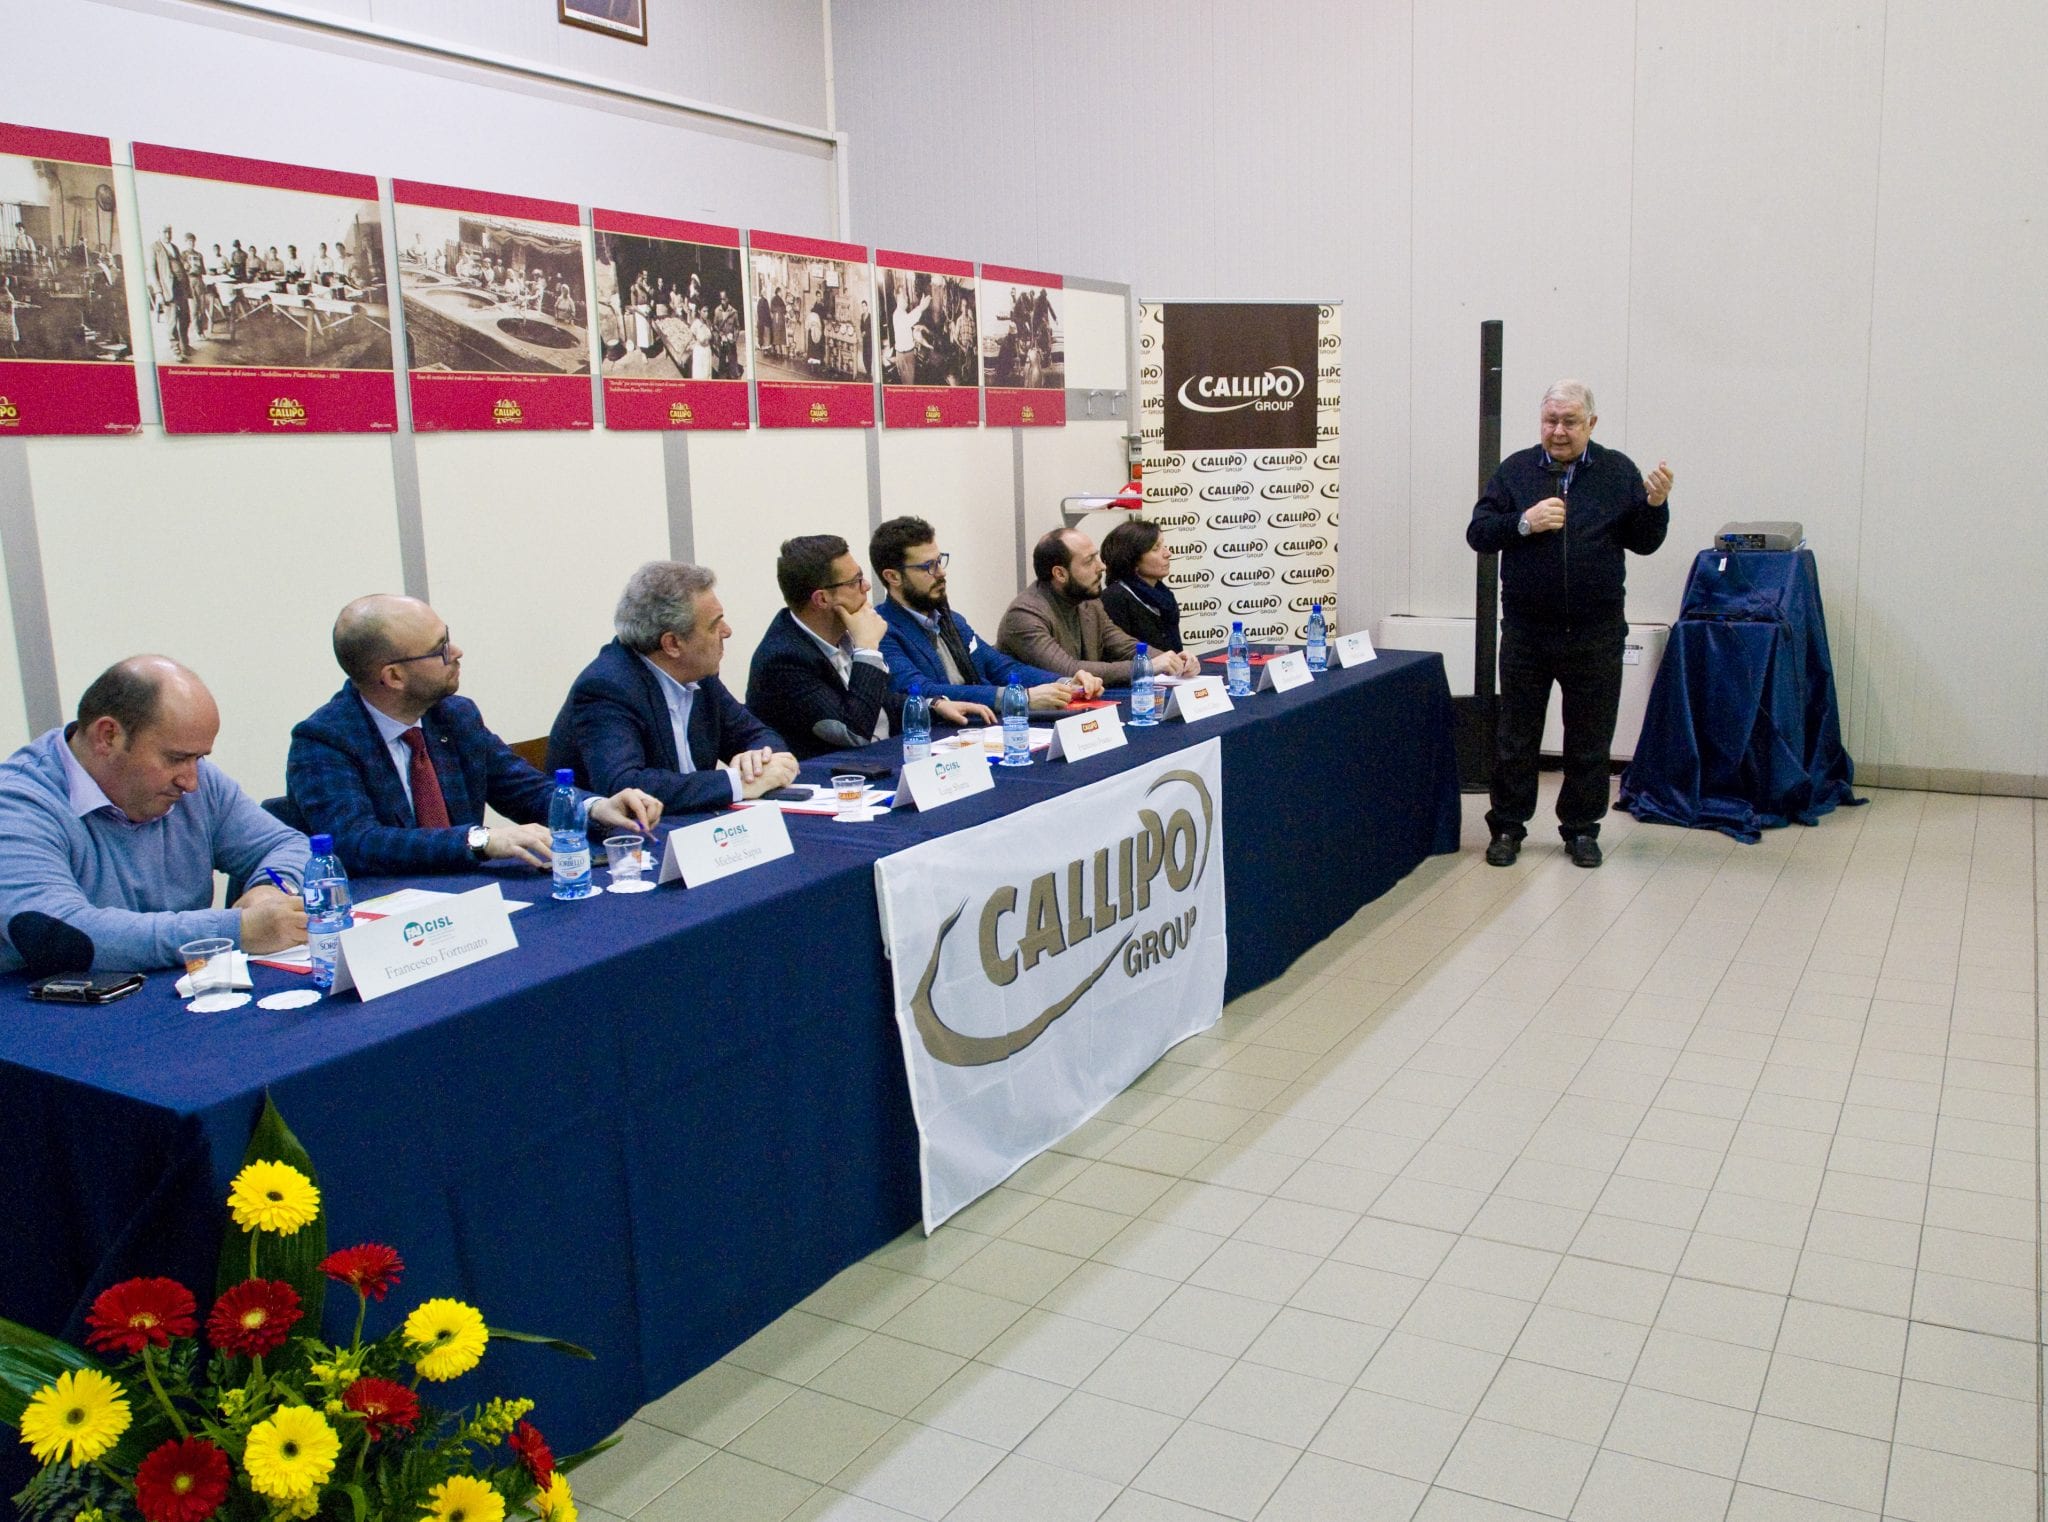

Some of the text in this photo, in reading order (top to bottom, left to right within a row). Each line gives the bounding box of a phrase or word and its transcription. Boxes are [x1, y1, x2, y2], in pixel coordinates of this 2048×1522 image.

[1198, 371, 1293, 398] CALLIPO
[269, 407, 305, 417] CALLIPO
[493, 407, 522, 417] CALLIPO
[1255, 401, 1294, 412] GROUP
[1200, 455, 1242, 466] CALLIPO
[1262, 454, 1302, 465] CALLIPO
[1146, 486, 1188, 497] CALLIPO
[1208, 484, 1249, 496] CALLIPO
[1269, 483, 1309, 494] CALLIPO
[1215, 513, 1256, 524] CALLIPO
[1276, 511, 1316, 522] CALLIPO
[1166, 543, 1203, 554] ALLIPO
[1223, 541, 1263, 552] CALLIPO
[1283, 539, 1323, 550] CALLIPO
[1168, 572, 1209, 583] CALLIPO
[1229, 569, 1270, 581] CALLIPO
[1290, 567, 1330, 579] CALLIPO
[1236, 597, 1277, 609] CALLIPO
[1183, 628, 1224, 640] CALLIPO
[1243, 625, 1284, 636] CALLIPO
[727, 824, 748, 837] CISL
[979, 808, 1198, 987] CALLIPO
[424, 915, 454, 932] CISL
[1122, 905, 1198, 978] GROUP
[384, 938, 489, 980] Francesco Fortunato
